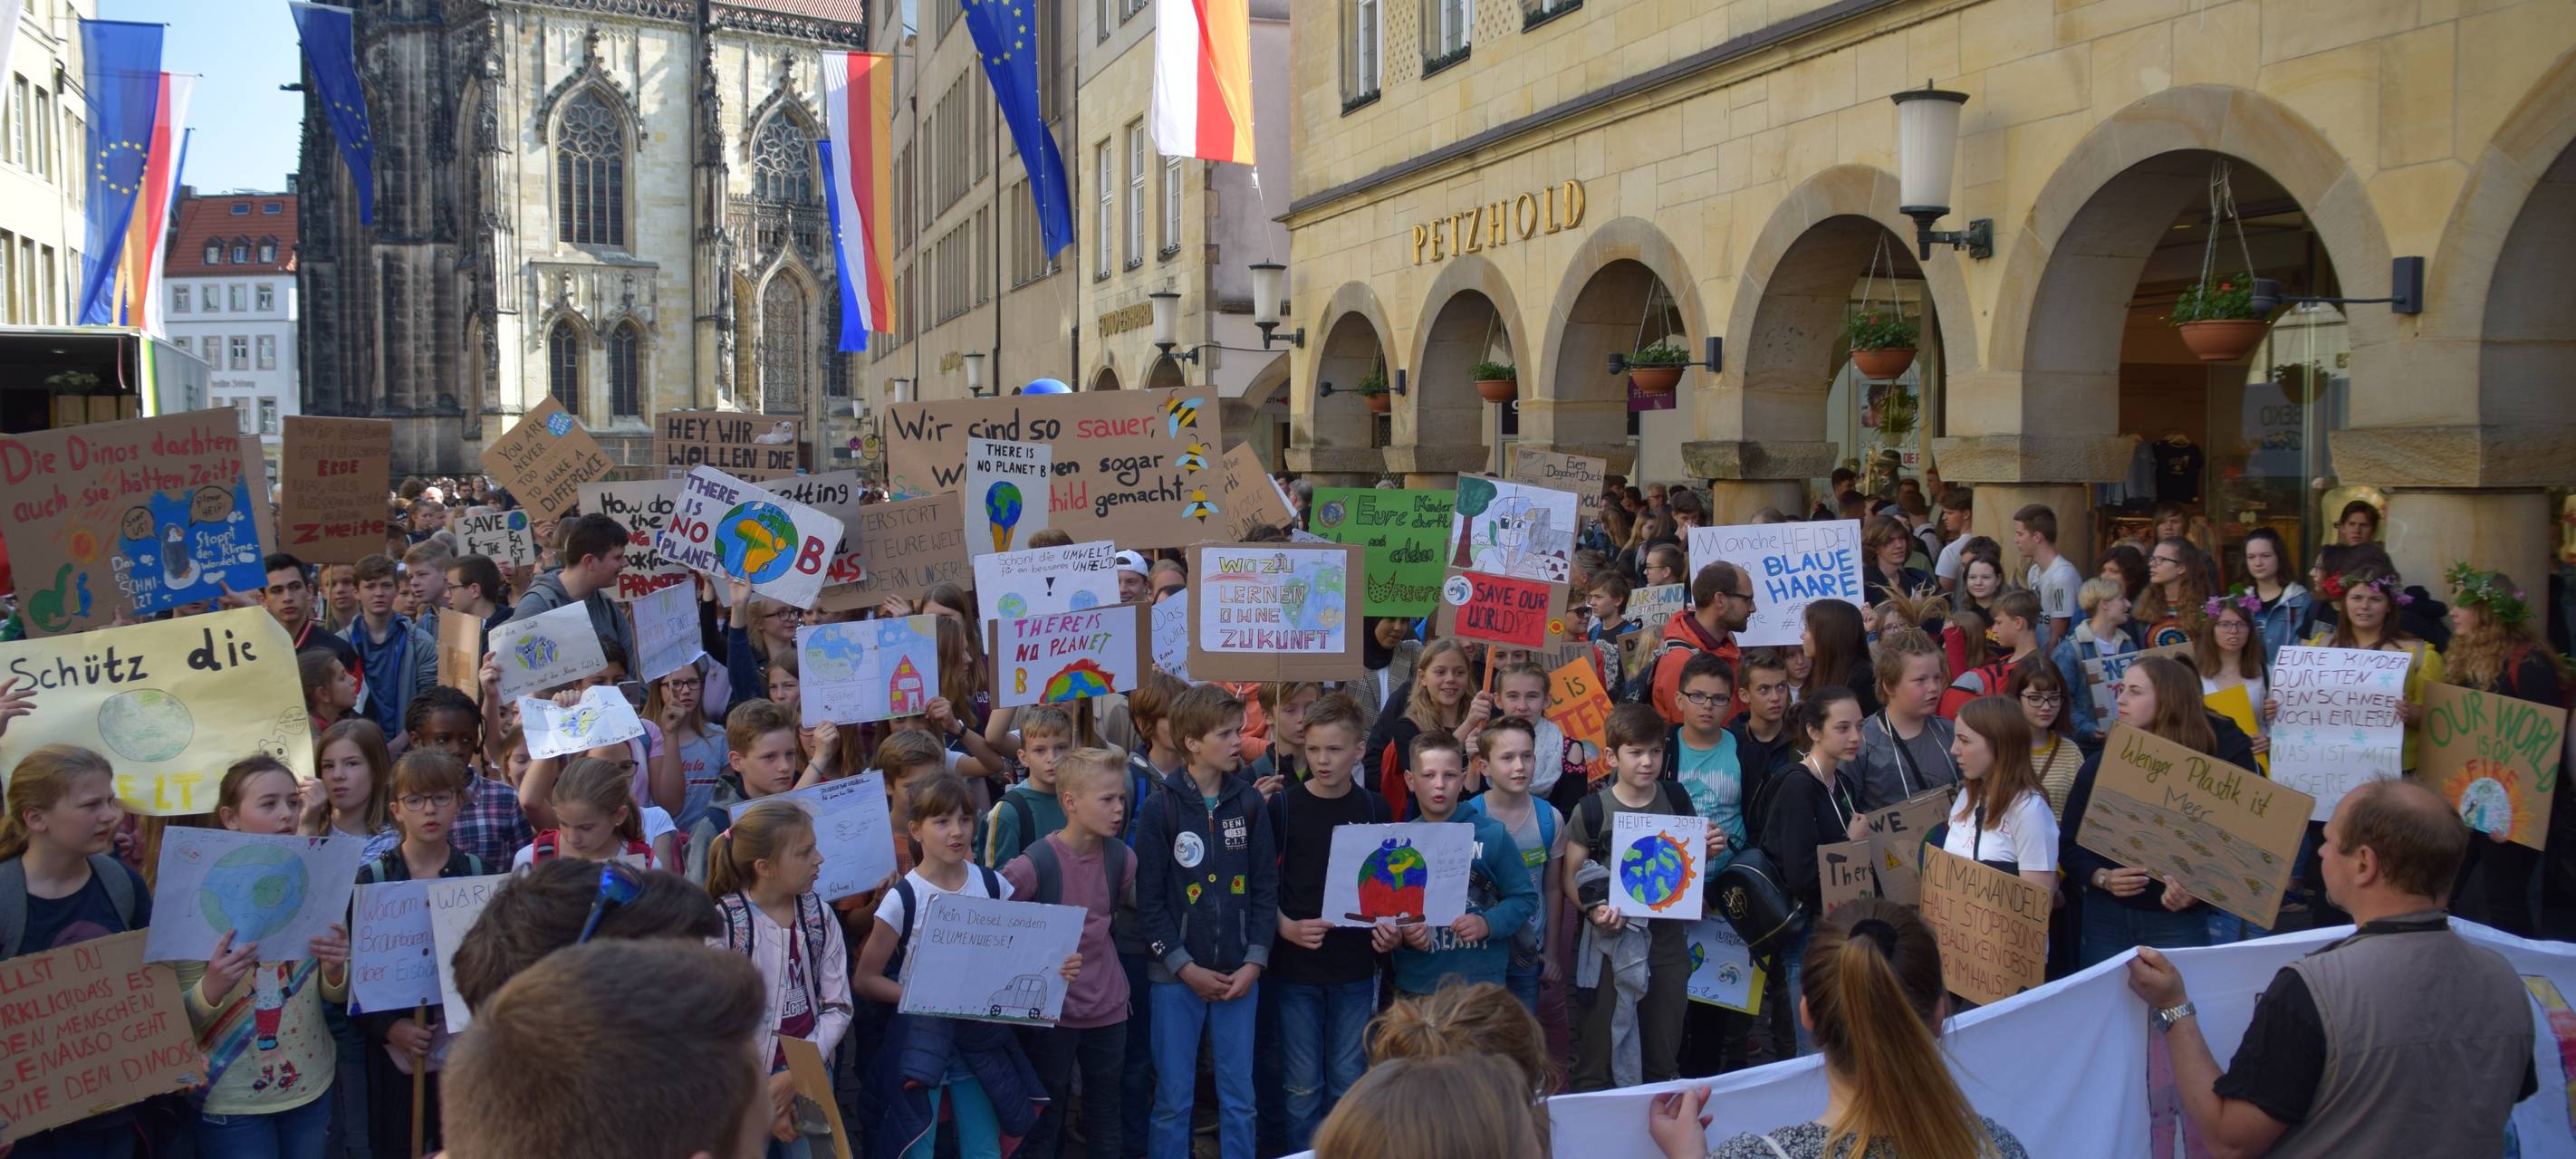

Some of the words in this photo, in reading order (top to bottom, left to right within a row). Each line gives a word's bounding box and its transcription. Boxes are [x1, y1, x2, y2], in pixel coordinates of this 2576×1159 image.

[1413, 179, 1585, 265] PETZHOLD
[717, 420, 753, 444] WIR
[891, 407, 953, 442] Wir
[1029, 419, 1061, 441] so
[1076, 416, 1156, 439] sauer,
[498, 442, 523, 462] YOU
[525, 417, 546, 442] ARE
[985, 444, 1022, 458] THERE
[1026, 447, 1034, 459] IS
[0, 438, 56, 485] Die
[68, 435, 139, 472] Dinos
[151, 426, 238, 456] dachten
[317, 459, 360, 477] ERDE
[514, 442, 546, 474] NEVER
[668, 446, 757, 469] WOLLEN
[767, 450, 795, 470] DIE
[977, 460, 991, 473] NO
[996, 460, 1035, 475] PLANET
[1040, 465, 1046, 478] B
[526, 486, 542, 499] TO
[544, 458, 572, 488] MAKE
[574, 449, 585, 462] A
[540, 453, 606, 513] DIFFERENCE
[1100, 455, 1164, 486] sogar
[13, 484, 68, 522] auch
[82, 481, 111, 507] sie
[120, 465, 185, 495] hätten
[188, 459, 241, 486] Zeit!
[601, 493, 642, 515] How
[649, 493, 674, 514] do
[687, 473, 740, 506] THERE
[1095, 474, 1184, 518] gemacht
[464, 514, 504, 535] SAVE
[629, 513, 663, 531] the
[1356, 494, 1408, 526] Eure
[196, 526, 235, 549] Stoppt
[668, 513, 709, 543] NO
[1693, 531, 1779, 556] Manche
[1781, 526, 1859, 556] HELDEN
[197, 549, 214, 559] den
[484, 541, 503, 556] THE
[659, 538, 724, 573] PLANET
[795, 535, 826, 575] B
[885, 535, 928, 560] EURE
[931, 529, 966, 551] WELT
[1039, 551, 1055, 561] die
[1062, 544, 1113, 560] UMWELT
[111, 556, 135, 571] Das
[1219, 555, 1294, 574] WOZU
[1763, 549, 1855, 577] BLAUE
[1219, 585, 1305, 604] LERNEN
[1475, 582, 1514, 604] SAVE
[1518, 590, 1549, 609] OUR
[1765, 571, 1859, 604] HAARE
[1014, 613, 1081, 638] THERE
[1084, 612, 1102, 630] IS
[1153, 606, 1184, 632] Das
[1220, 608, 1280, 624] OHNE
[1015, 644, 1039, 663] NO
[1050, 632, 1112, 657] PLANET
[1220, 628, 1330, 650] ZUKUNFT
[10, 646, 149, 692] Schütz
[187, 627, 258, 671] die
[2277, 649, 2328, 667] EURE
[2343, 650, 2408, 669] KINDER
[1014, 667, 1028, 694] B
[1566, 676, 1586, 698] is
[2273, 668, 2372, 688] DURFTEN
[2273, 689, 2310, 707] DEN
[2318, 689, 2396, 708] SCHNEE
[2272, 745, 2310, 763] WAS
[2321, 744, 2349, 762] IST
[2357, 745, 2398, 764] MIT
[2427, 690, 2488, 748] OUR
[2494, 697, 2560, 793] WORLD
[2476, 735, 2491, 756] IS
[2492, 742, 2514, 766] ON
[2119, 734, 2174, 783] Weniger
[2186, 756, 2242, 806] Plastik
[2249, 790, 2273, 819] ist
[2465, 759, 2520, 790] FIRE
[116, 770, 205, 812] ELT
[2163, 785, 2214, 821] Meer
[1618, 815, 1652, 829] HEUTE
[1674, 817, 1703, 830] 2099
[1826, 853, 1875, 887] There
[437, 885, 492, 910] WAR
[1923, 851, 2050, 924] KLIMAWANDEL?
[937, 905, 960, 922] Kein
[967, 908, 1001, 926] Diesel
[1007, 917, 1047, 930] sondern
[1922, 890, 1956, 924] HALT
[932, 928, 1014, 949] BLUMENWIESE!
[1939, 923, 1970, 953] BALD
[2001, 950, 2036, 981] OBST
[74, 943, 102, 972] DU
[126, 965, 155, 991] ES
[56, 991, 155, 1040] MENSCHEN
[120, 1011, 168, 1043] GEHT
[1, 1087, 52, 1125] WIE
[64, 1063, 111, 1101] DEN
